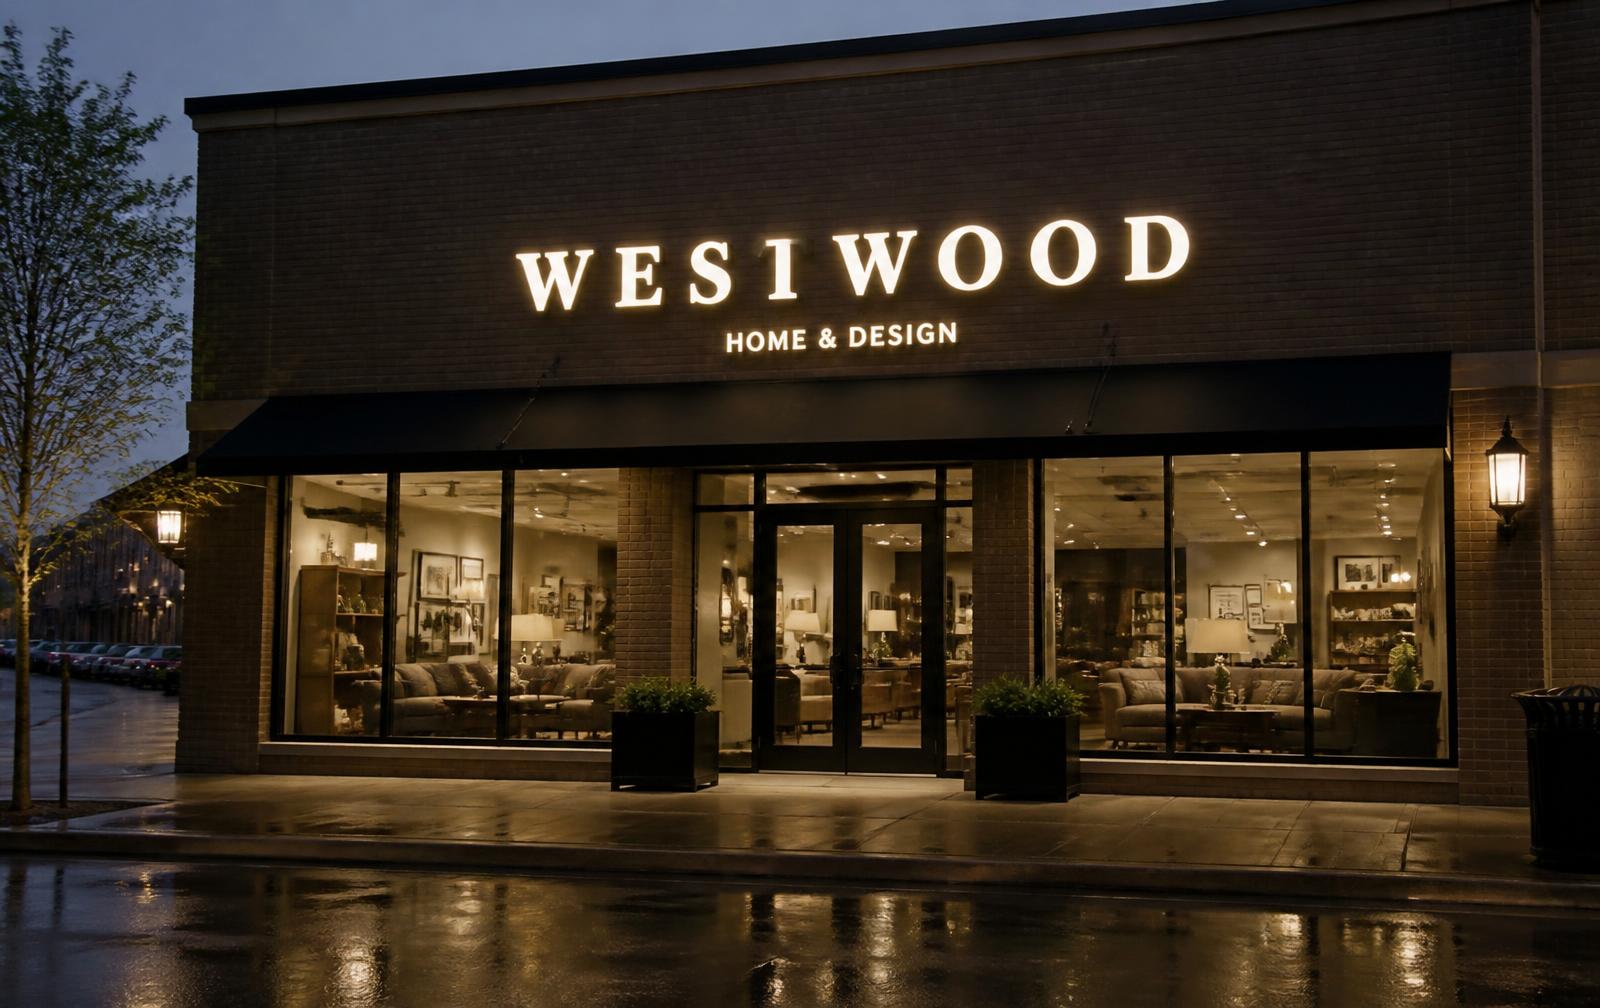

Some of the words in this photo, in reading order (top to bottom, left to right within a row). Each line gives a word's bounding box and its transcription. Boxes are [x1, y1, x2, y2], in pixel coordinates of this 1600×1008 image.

[726, 329, 807, 353] HOME
[818, 327, 837, 349] &
[848, 321, 957, 348] DESIGN
